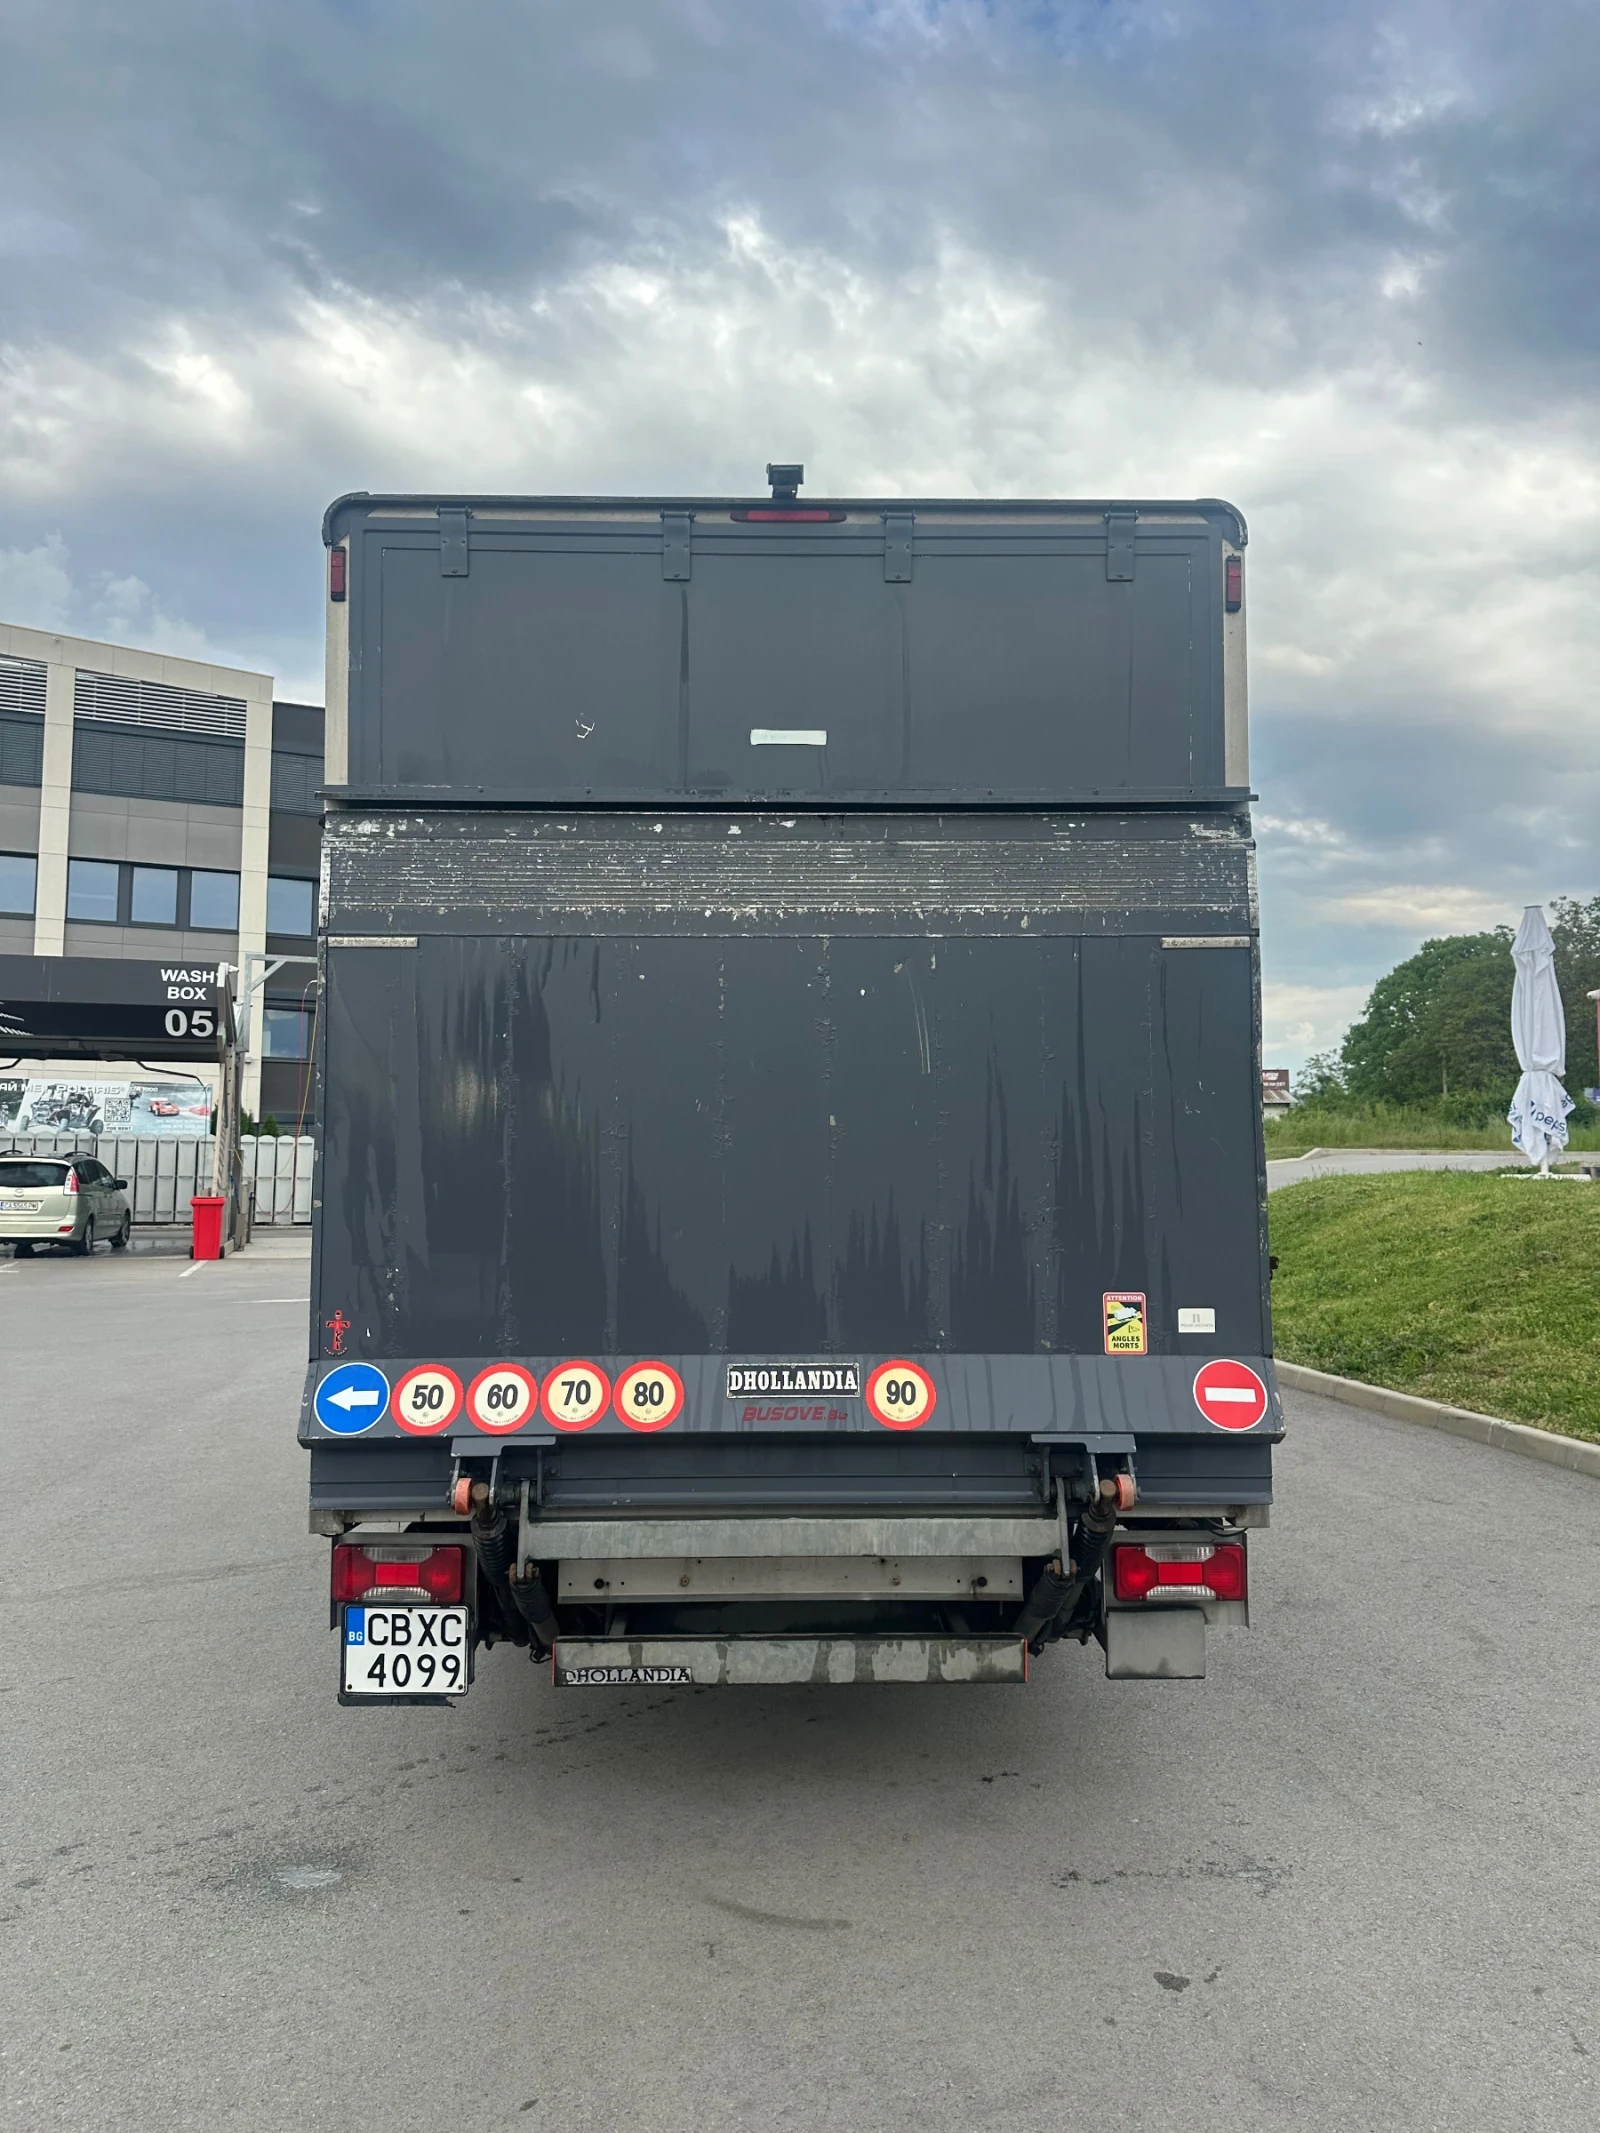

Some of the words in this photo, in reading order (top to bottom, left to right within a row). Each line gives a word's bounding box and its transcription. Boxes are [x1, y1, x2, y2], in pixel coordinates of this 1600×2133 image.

[161, 969, 214, 983] WASH
[167, 986, 207, 1000] BOX
[165, 1009, 214, 1037] 05
[561, 1380, 591, 1406] 70
[730, 1370, 858, 1391] DHOLLANDIA
[886, 1379, 917, 1406] 90
[412, 1384, 444, 1410] 50
[487, 1384, 518, 1409] 60
[633, 1381, 664, 1407] 80
[348, 1631, 363, 1642] BG
[367, 1653, 461, 1688] 4099
[566, 1668, 690, 1682] DHOLLANDIA
